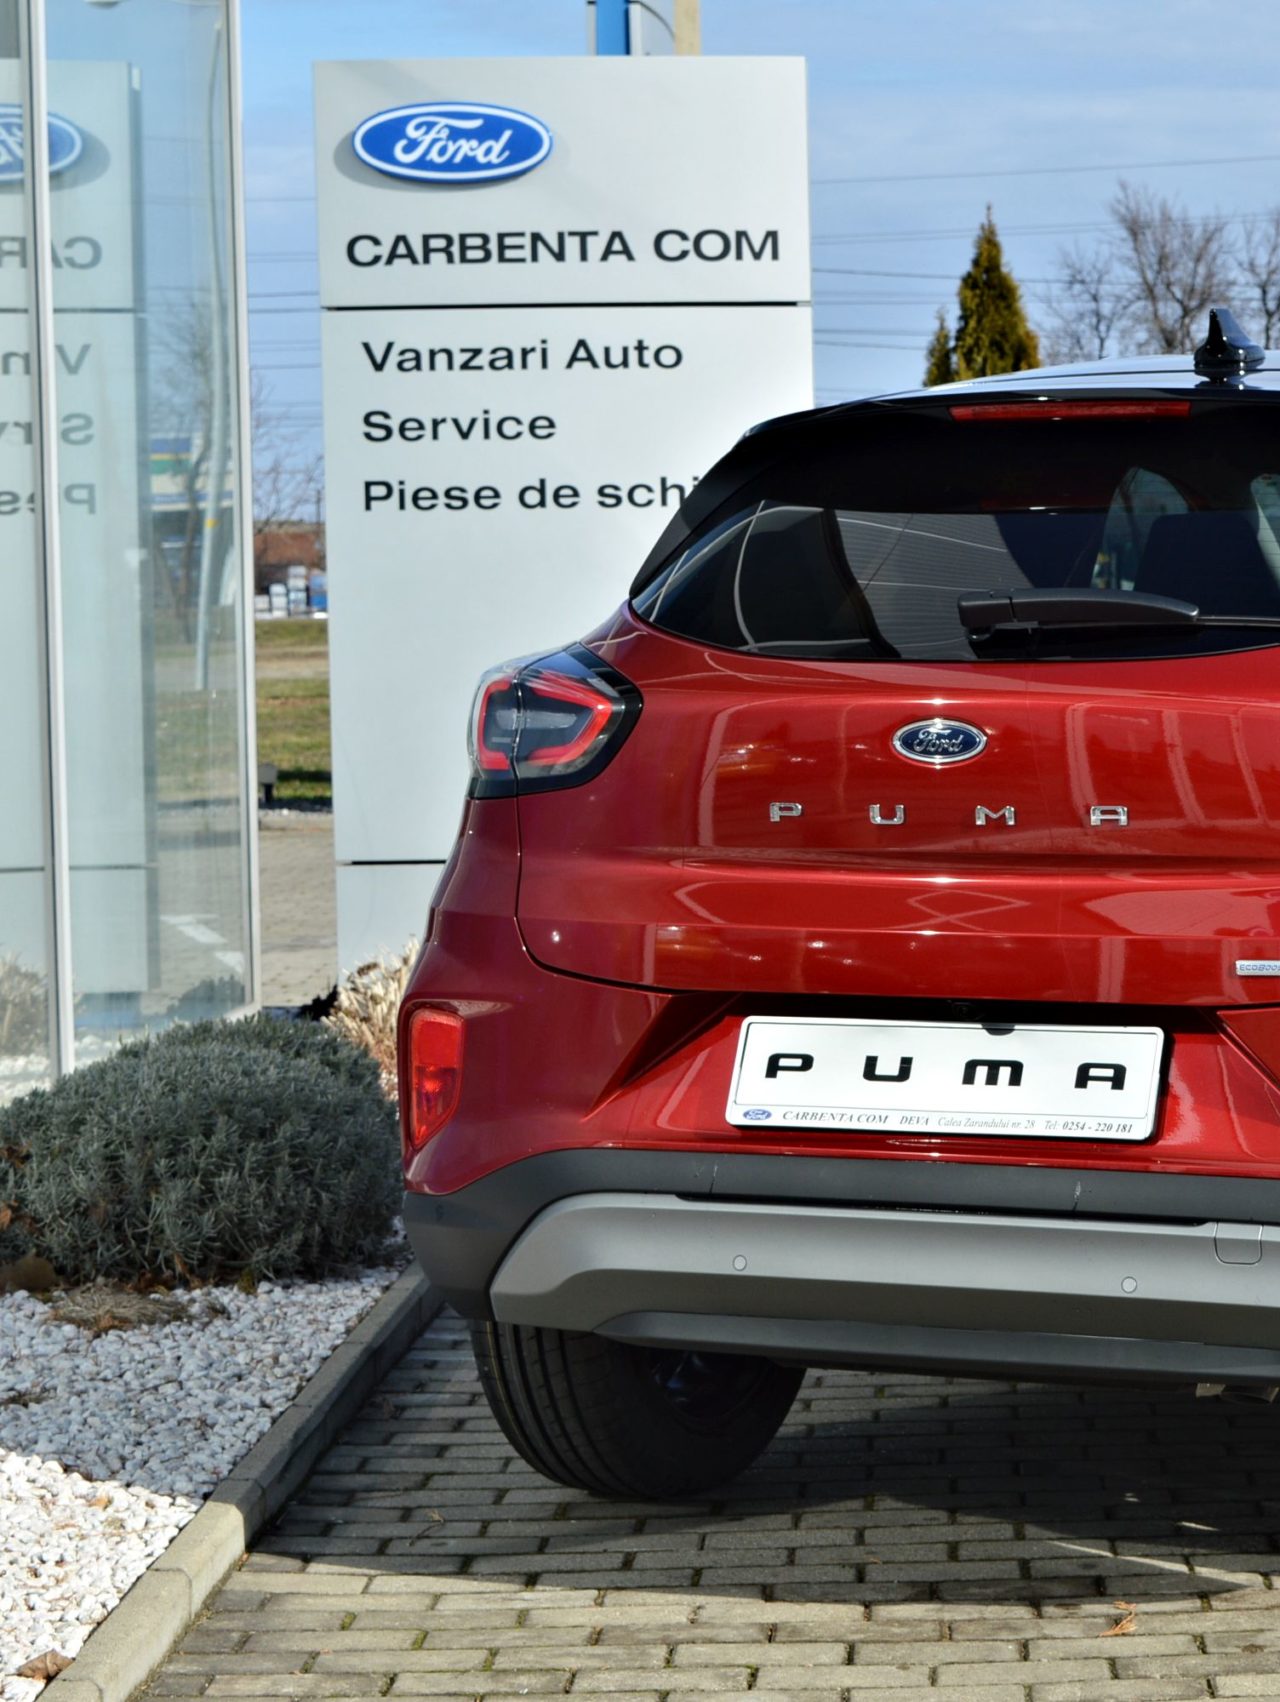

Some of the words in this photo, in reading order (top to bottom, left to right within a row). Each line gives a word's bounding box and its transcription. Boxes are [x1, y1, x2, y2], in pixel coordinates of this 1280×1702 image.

[394, 115, 513, 164] Ford
[346, 230, 636, 268] CARBENTA
[652, 228, 780, 262] COM
[361, 338, 550, 372] Vanzari
[565, 338, 684, 370] Auto
[362, 409, 557, 442] Service
[363, 480, 502, 511] Piese
[518, 478, 581, 509] de
[769, 801, 1128, 826] PUMA
[764, 1052, 1127, 1091] PUMA
[782, 1110, 853, 1123] CARBENTA
[857, 1113, 889, 1124] COM
[899, 1115, 929, 1126] DEVA
[937, 1116, 962, 1127] Calea
[1024, 1119, 1036, 1129] 28
[1062, 1121, 1086, 1131] 0254
[1095, 1122, 1113, 1132] 220
[1115, 1123, 1133, 1134] 181
